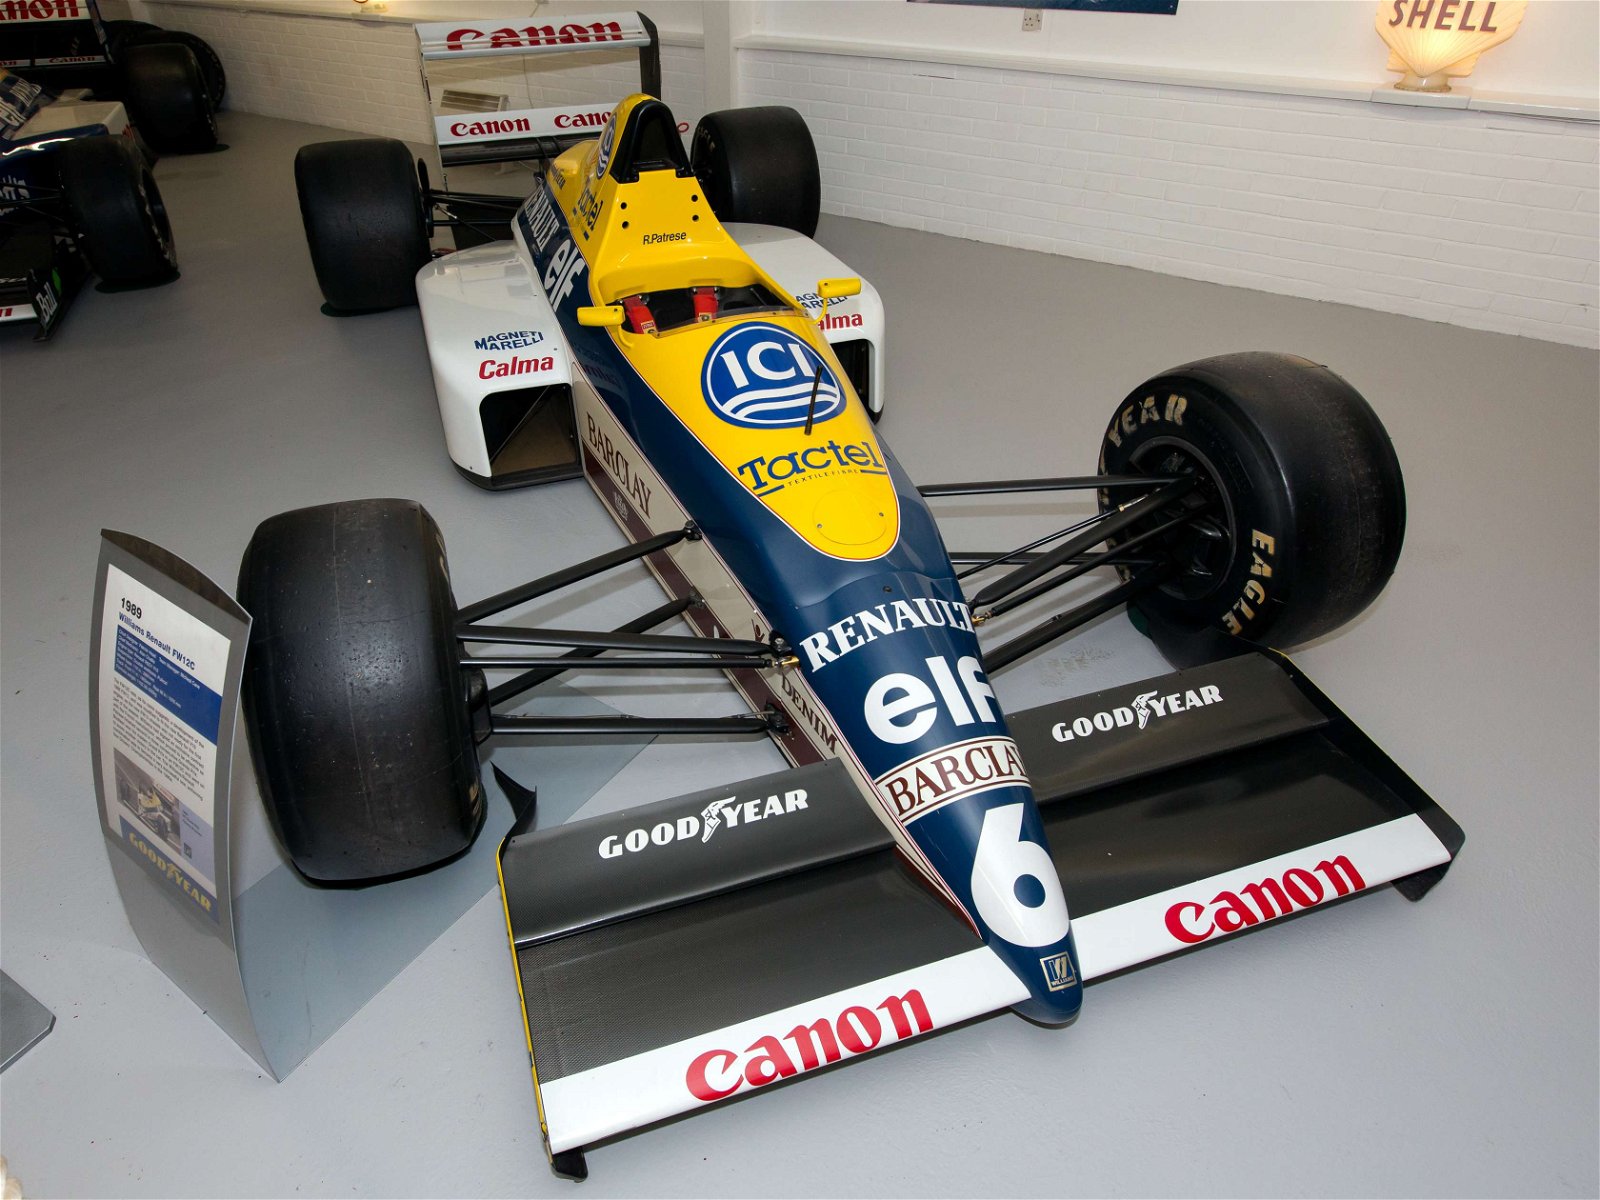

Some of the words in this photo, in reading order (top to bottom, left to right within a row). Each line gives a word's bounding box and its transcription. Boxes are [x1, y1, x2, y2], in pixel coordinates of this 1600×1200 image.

[446, 21, 623, 50] Canon
[1388, 0, 1498, 32] SHELL
[450, 117, 531, 137] Canon
[554, 110, 612, 128] Cano
[642, 231, 687, 246] R.Patrese
[544, 239, 586, 313] elf
[474, 330, 544, 350] MAGNETI
[474, 331, 544, 351] MARELLI
[818, 313, 863, 330] alma
[479, 356, 553, 380] Calma
[720, 341, 816, 389] ICI
[586, 411, 651, 519] BARCLAY
[737, 440, 884, 491] Tactel
[1221, 528, 1275, 636] EAGLE
[121, 597, 142, 619] 1989
[118, 611, 144, 636] Williams
[146, 630, 171, 654] Renault
[172, 648, 196, 671] FW12C
[799, 597, 975, 672] RENAULT
[781, 674, 838, 754] DENIM
[864, 656, 997, 744] elf
[972, 803, 1062, 948] 6
[1164, 854, 1365, 943] Canon
[685, 989, 932, 1101] Canon
